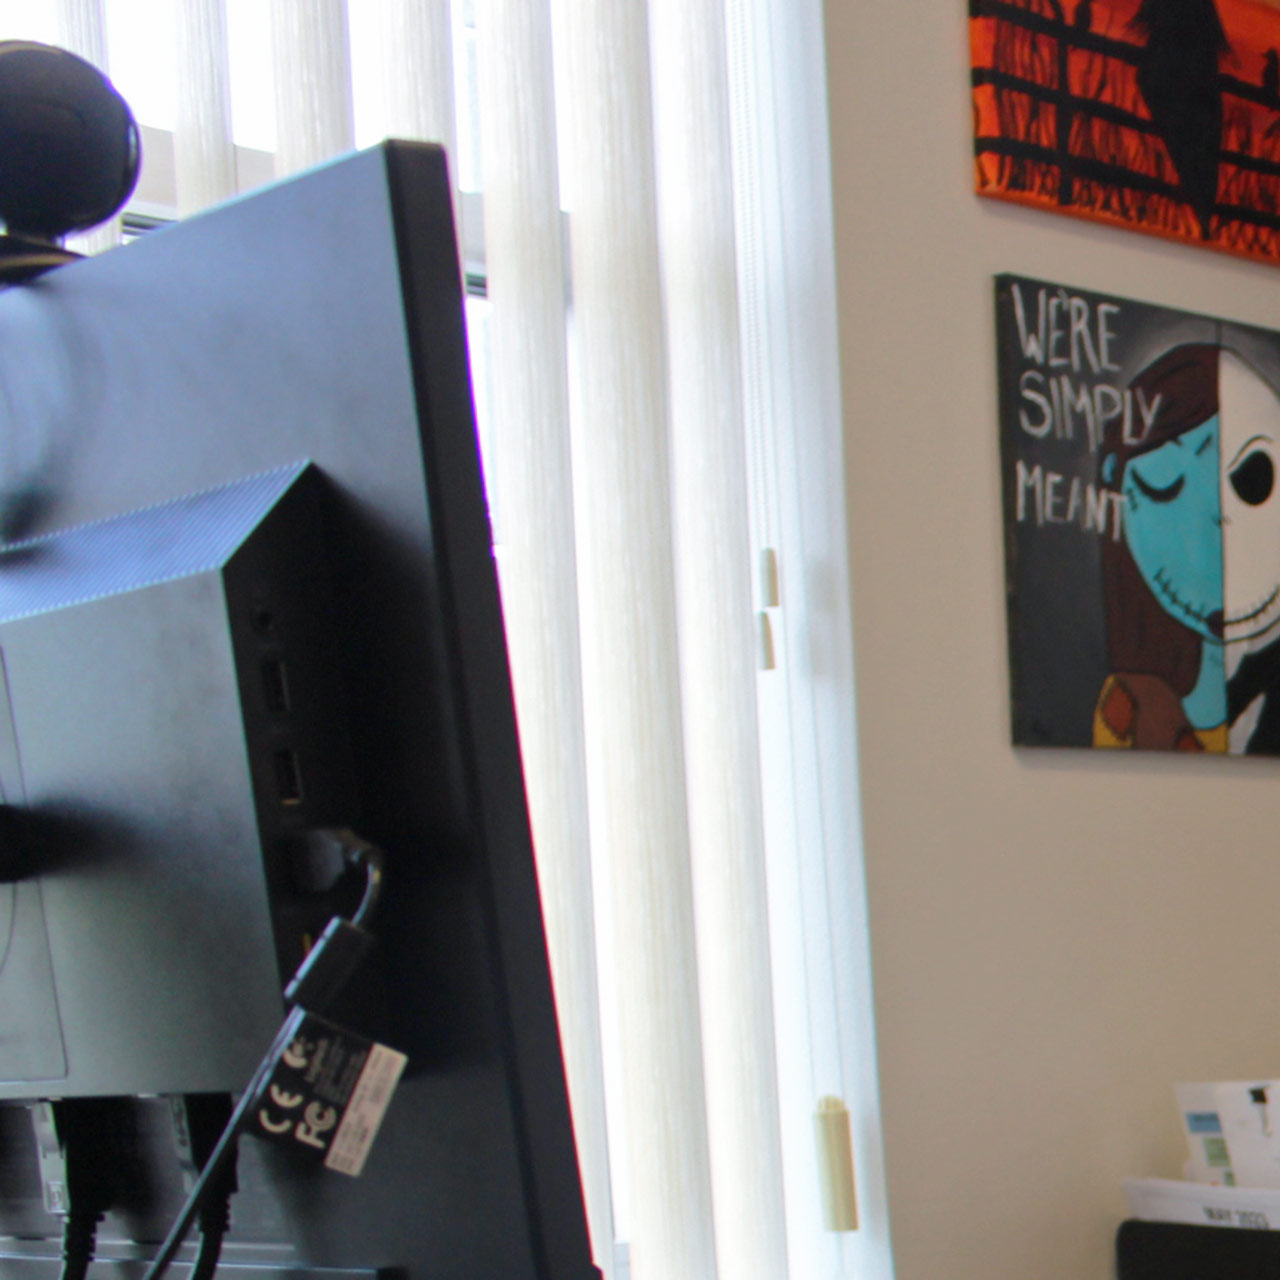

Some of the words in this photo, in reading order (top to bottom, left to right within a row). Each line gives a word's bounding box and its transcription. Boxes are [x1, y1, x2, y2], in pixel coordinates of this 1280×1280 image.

[1011, 283, 1120, 374] WE'RE
[1019, 369, 1162, 453] SIMPLY
[1016, 459, 1128, 542] MEANT
